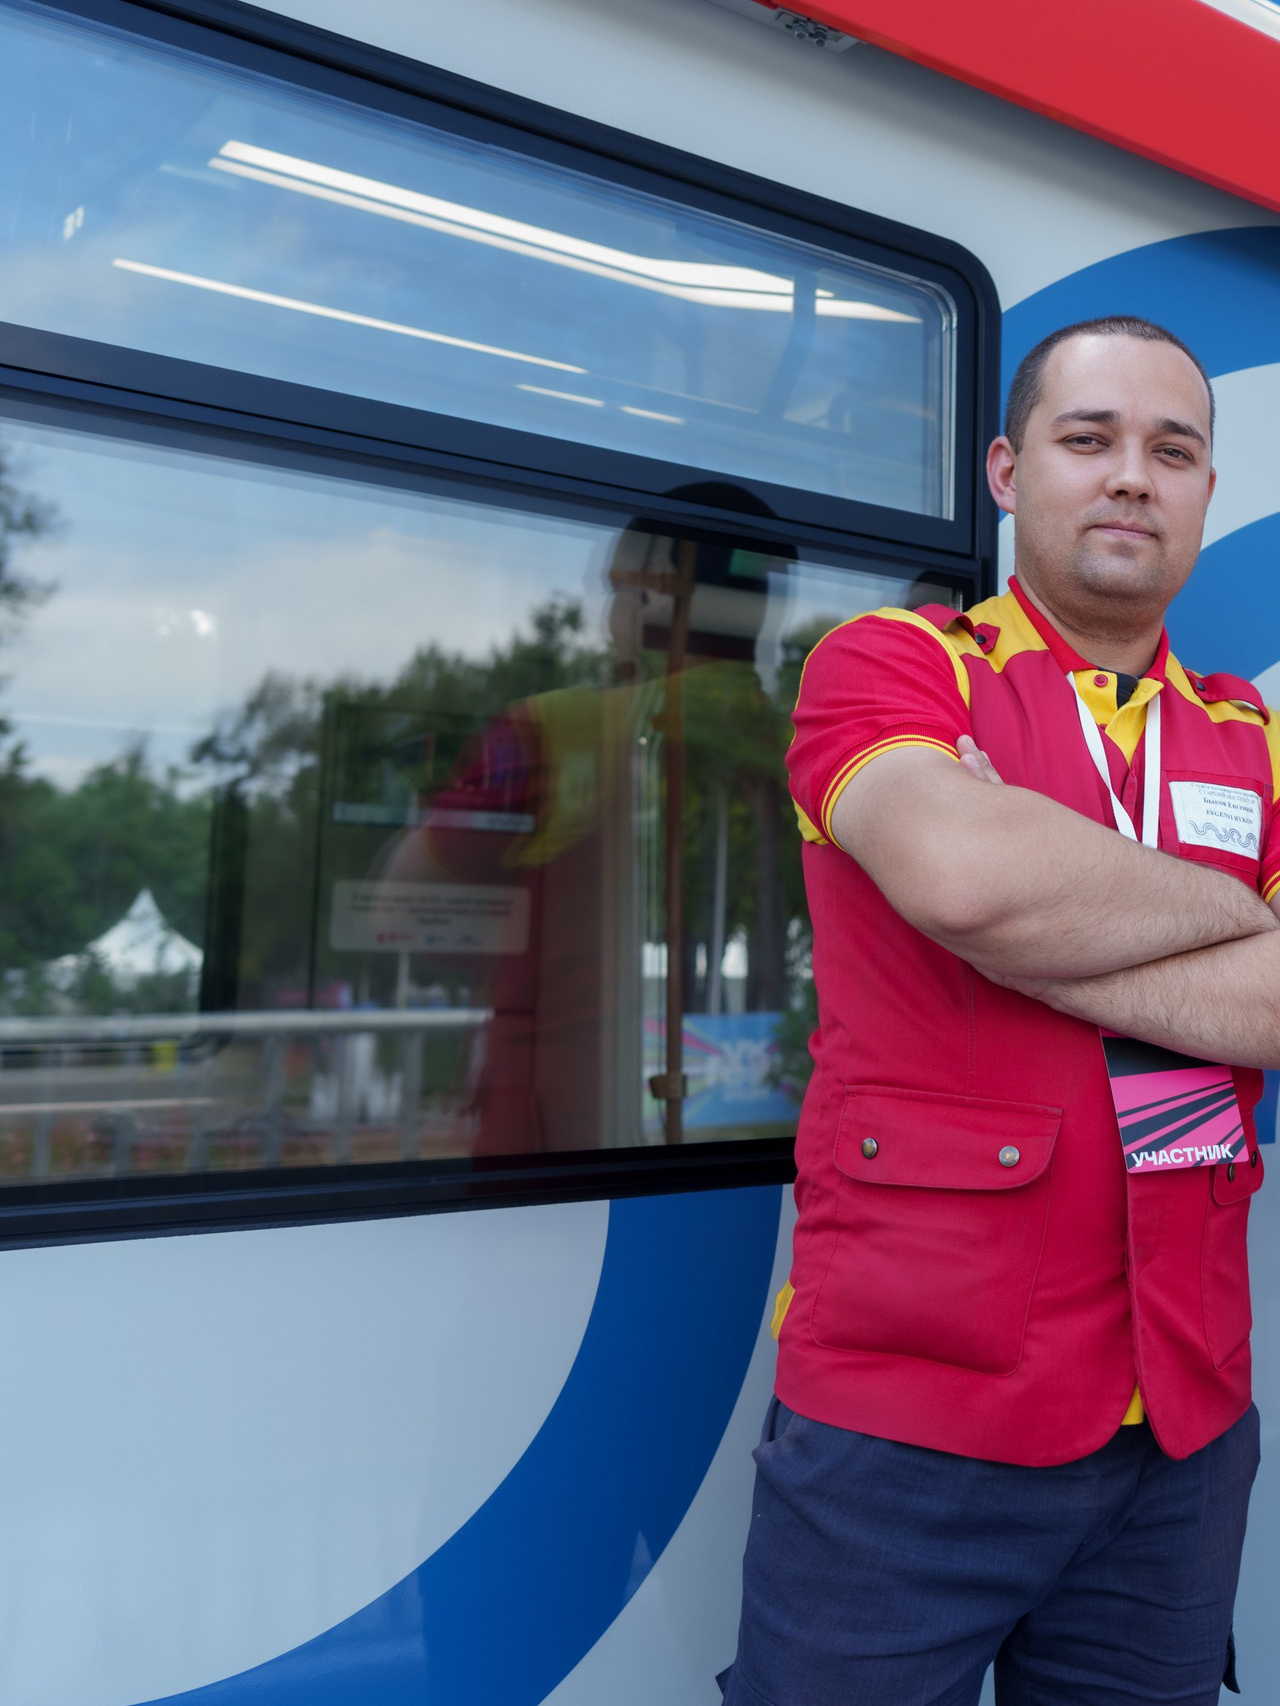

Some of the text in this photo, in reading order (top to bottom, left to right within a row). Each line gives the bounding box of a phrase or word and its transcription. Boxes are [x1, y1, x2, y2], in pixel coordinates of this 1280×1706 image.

[1203, 797, 1253, 813] Быков Евгений
[1131, 1143, 1234, 1167] УЧАСТНИК
